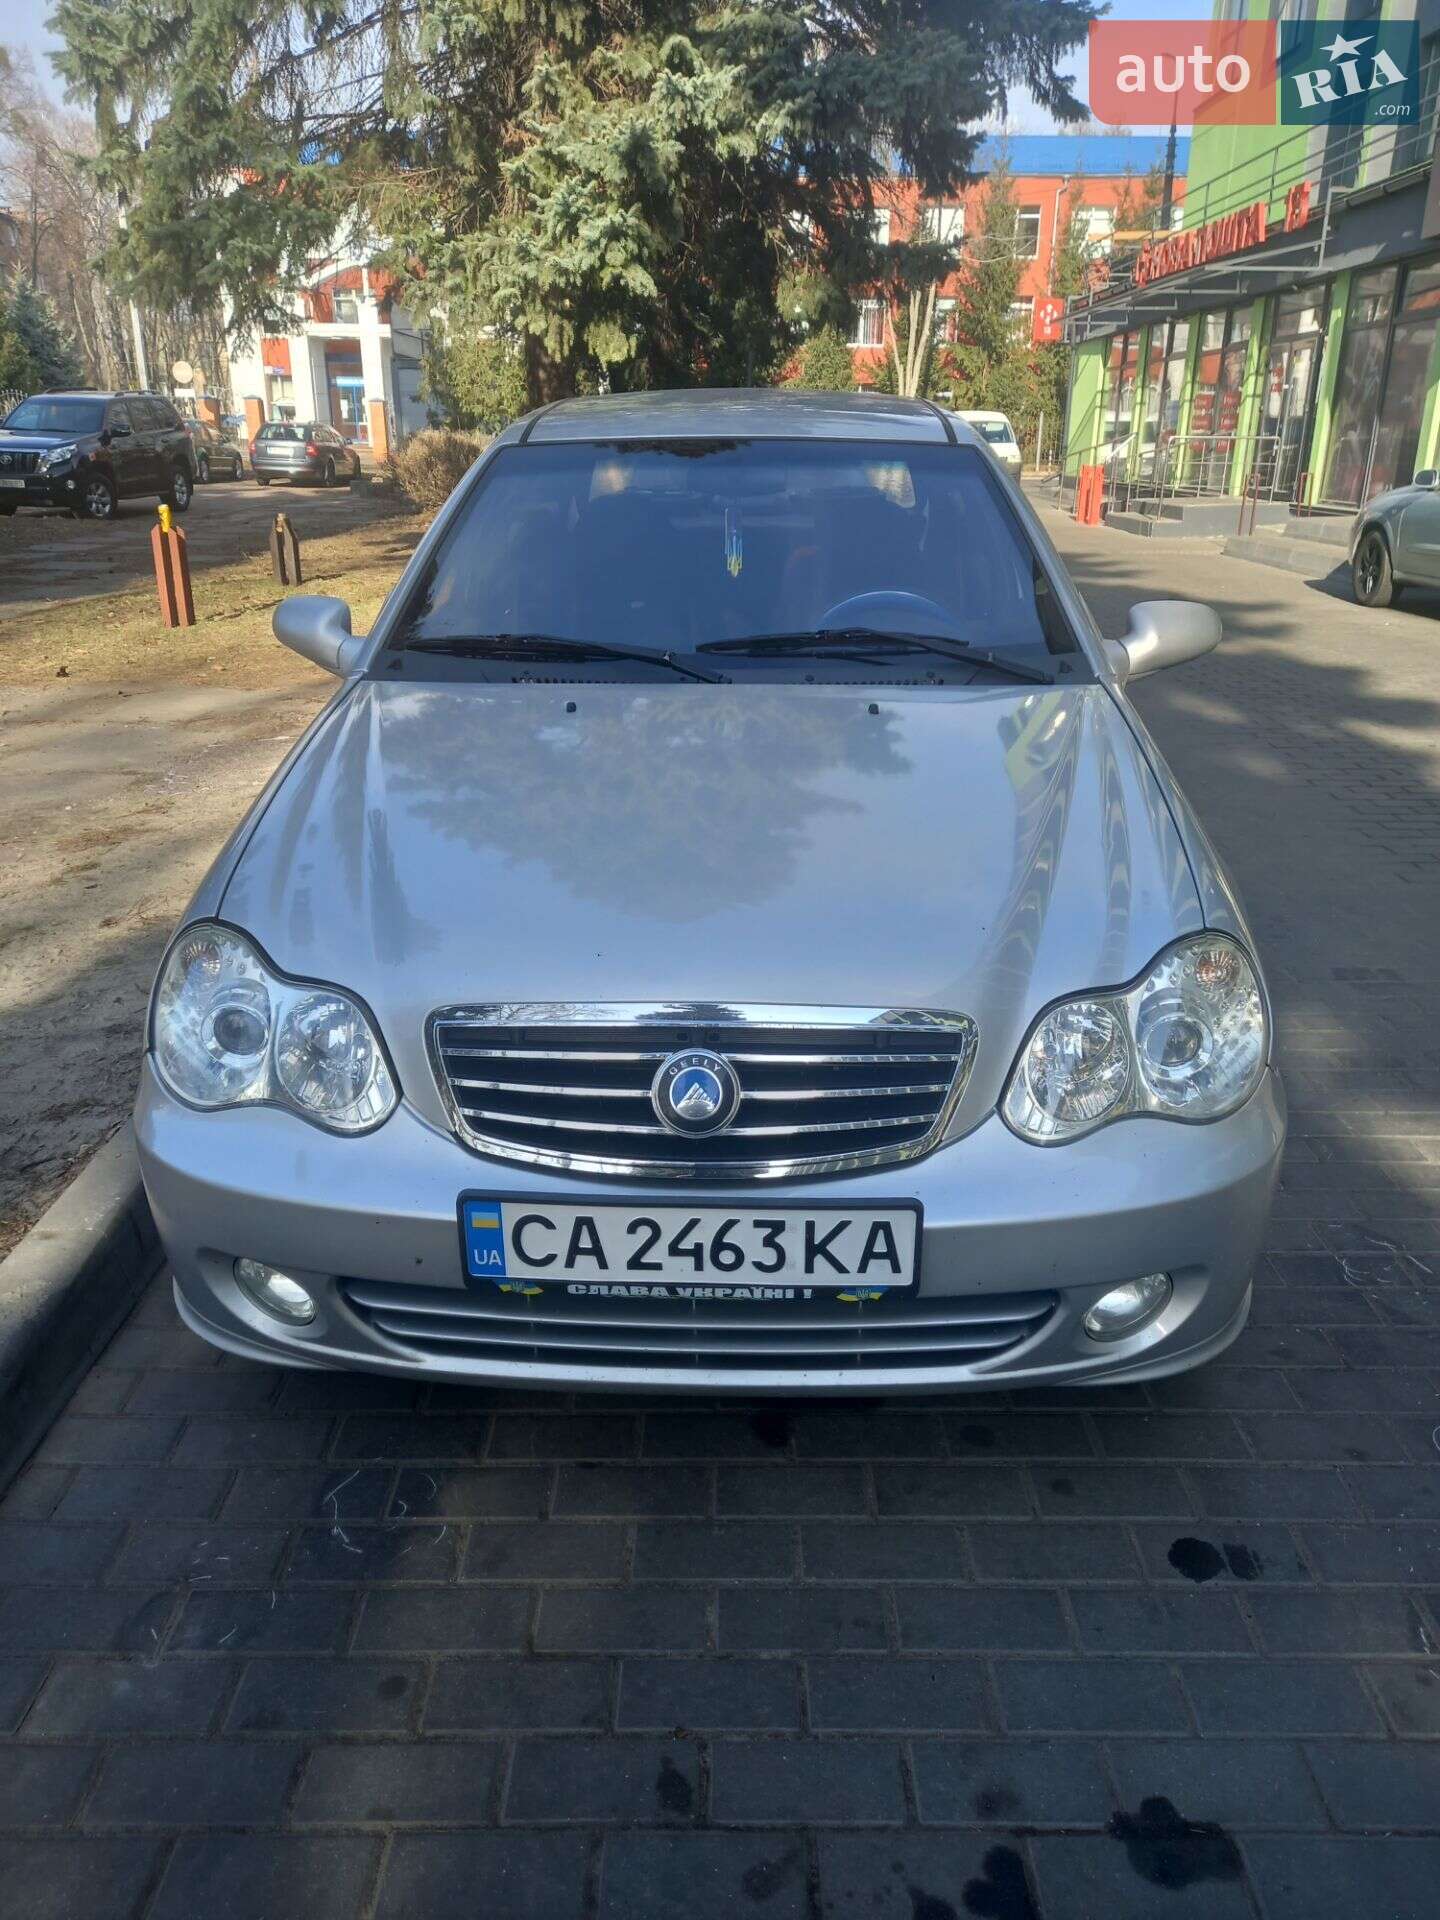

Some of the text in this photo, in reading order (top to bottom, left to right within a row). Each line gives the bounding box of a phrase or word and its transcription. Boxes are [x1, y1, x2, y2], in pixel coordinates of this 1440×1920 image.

[669, 1057, 721, 1075] GEELY
[512, 1213, 902, 1274] CA 2463 KA
[474, 1249, 502, 1266] UA
[566, 1283, 674, 1297] СЛАВА
